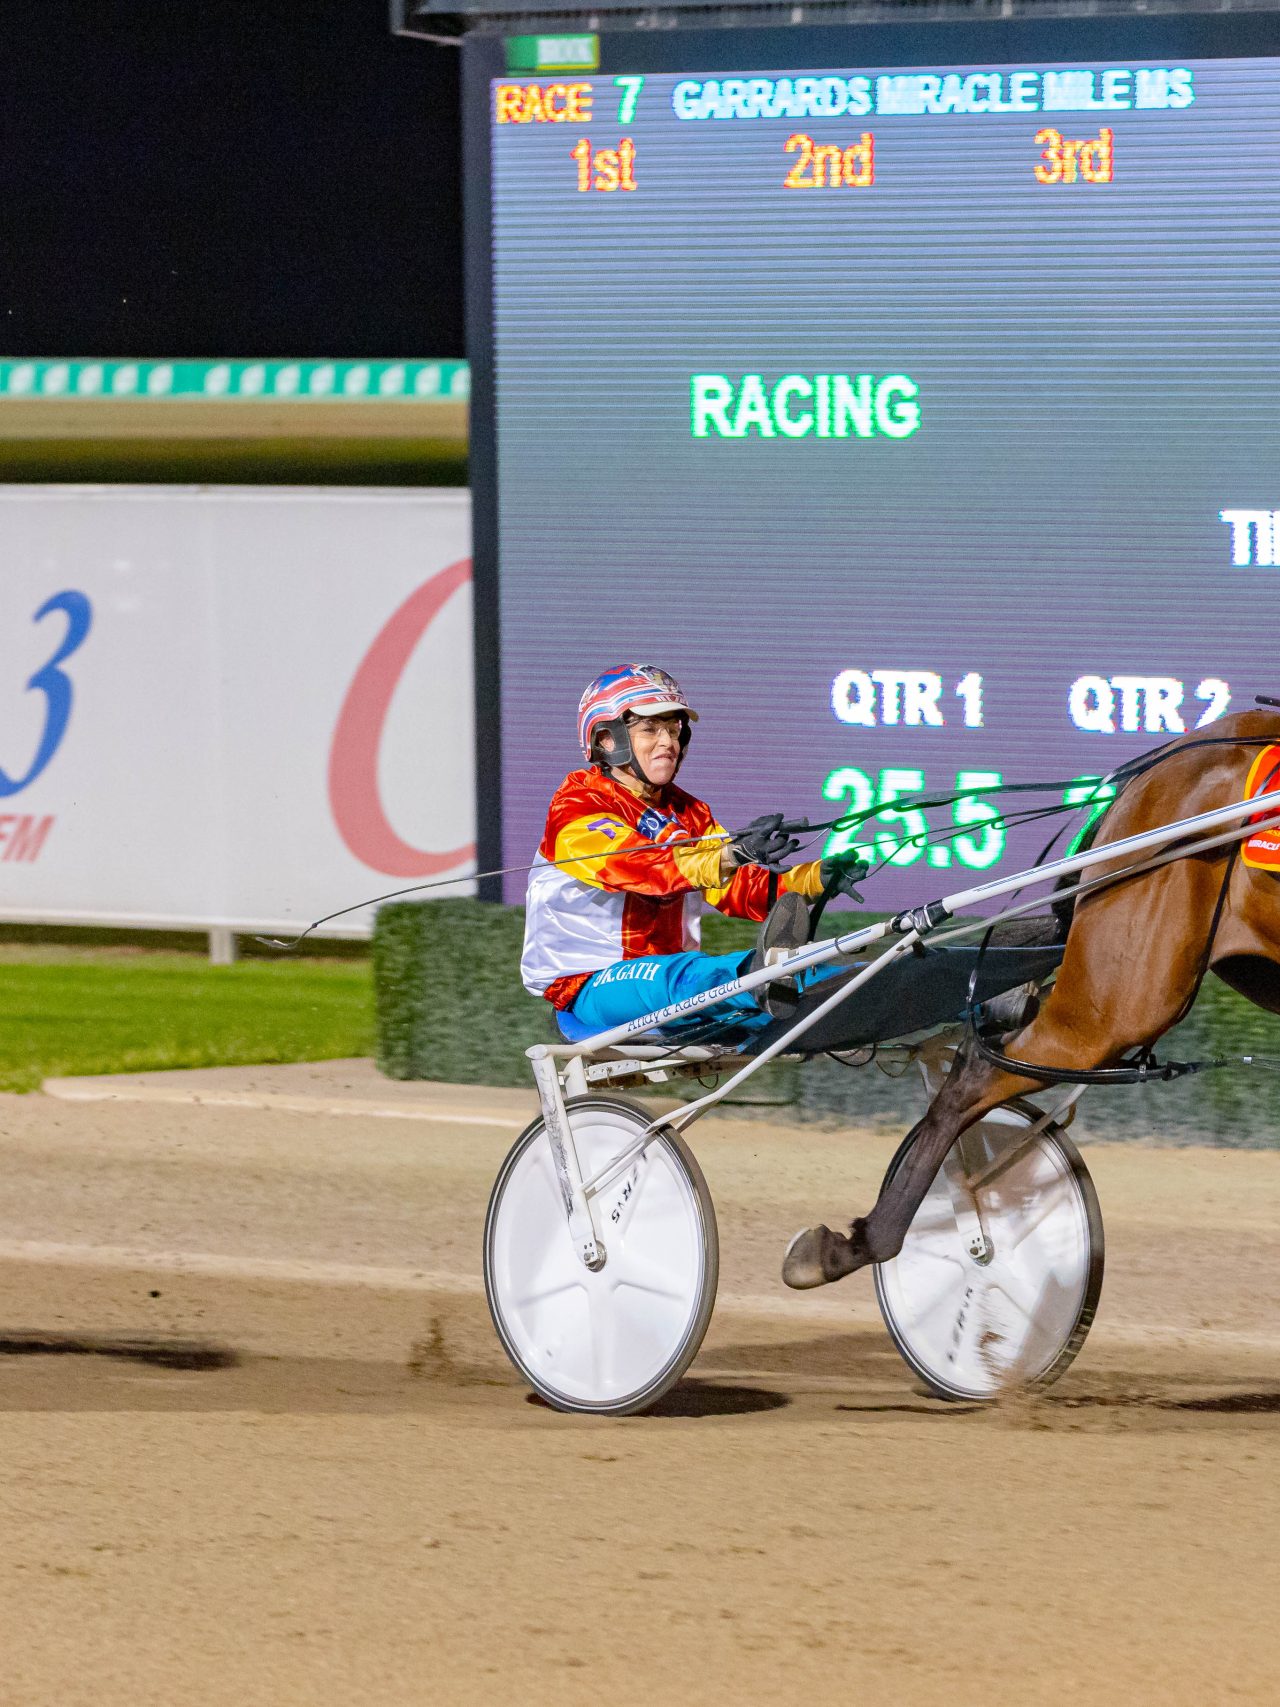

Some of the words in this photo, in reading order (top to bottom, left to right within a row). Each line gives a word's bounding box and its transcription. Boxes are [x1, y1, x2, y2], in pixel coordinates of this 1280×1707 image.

[496, 82, 593, 123] RACE
[613, 75, 645, 124] 7
[672, 76, 875, 120] GARRARDS
[875, 71, 1041, 115] MIRACLE
[1041, 69, 1133, 112] MILE
[570, 138, 637, 191] 1st
[783, 132, 875, 188] 2nd
[1034, 128, 1113, 184] 3rd
[691, 374, 922, 439] RACING
[831, 669, 947, 728] QTR
[955, 672, 984, 728] 1
[1067, 675, 1188, 735] QTR
[1194, 678, 1232, 730] 2
[821, 766, 1008, 871] 25.5
